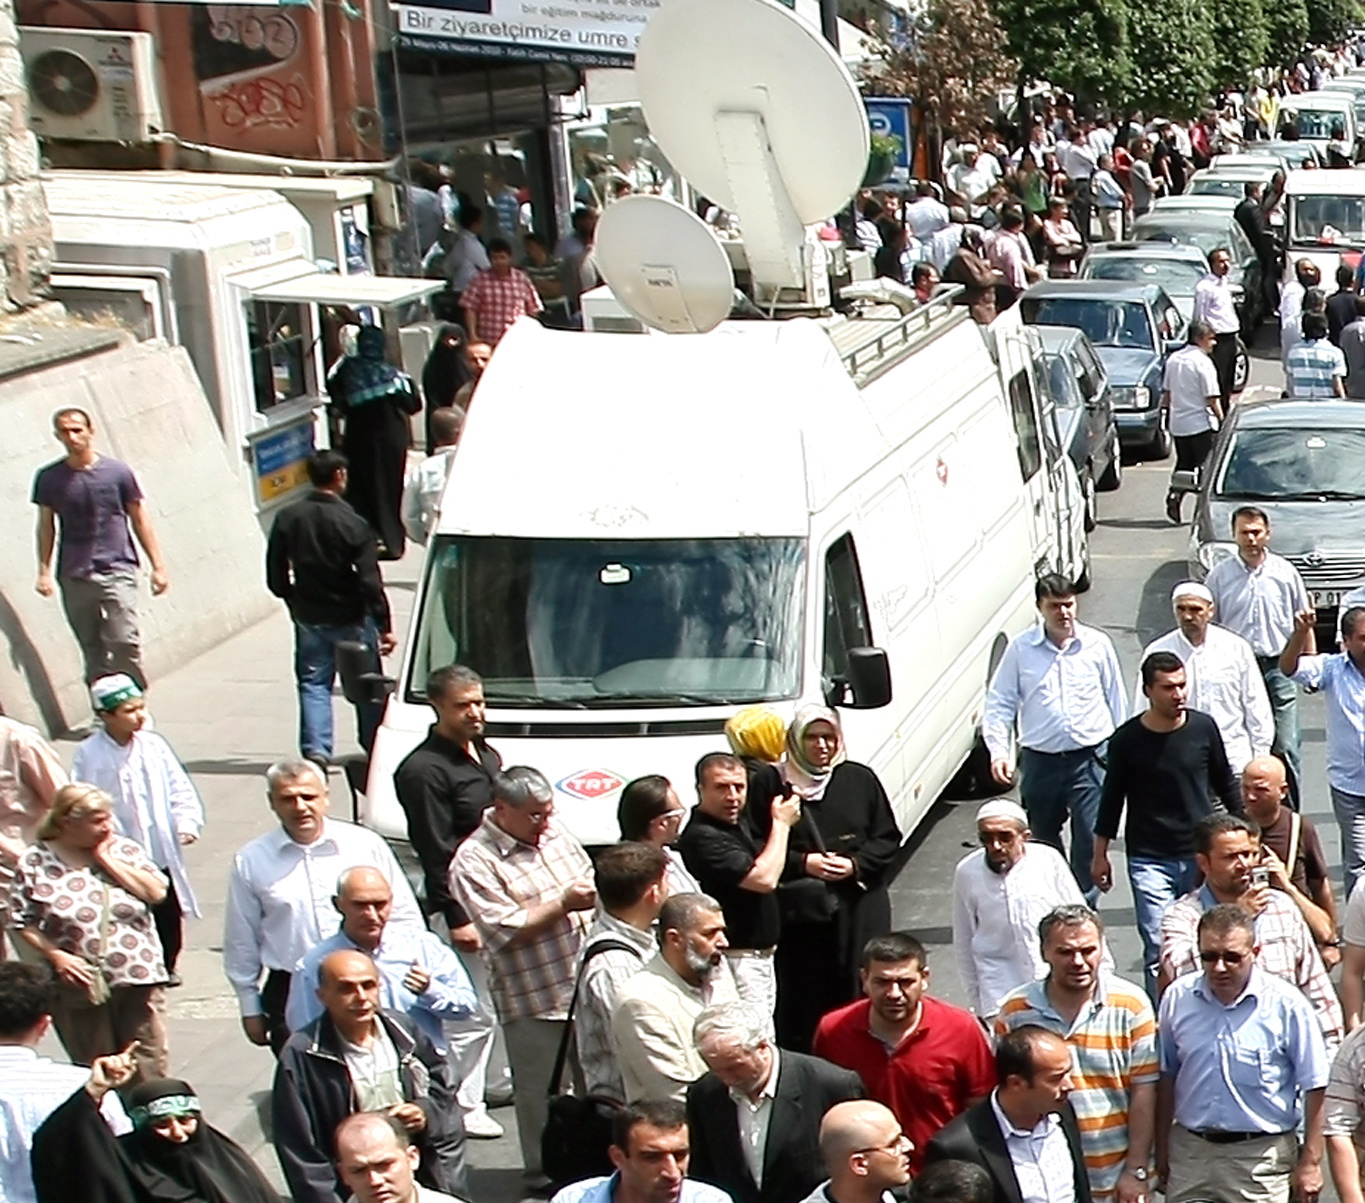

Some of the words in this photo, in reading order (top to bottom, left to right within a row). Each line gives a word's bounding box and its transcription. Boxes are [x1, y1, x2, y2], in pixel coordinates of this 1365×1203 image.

[407, 10, 433, 28] Bir
[440, 15, 572, 42] ziyaretçimize
[577, 31, 628, 48] umre
[573, 778, 614, 791] TRT
